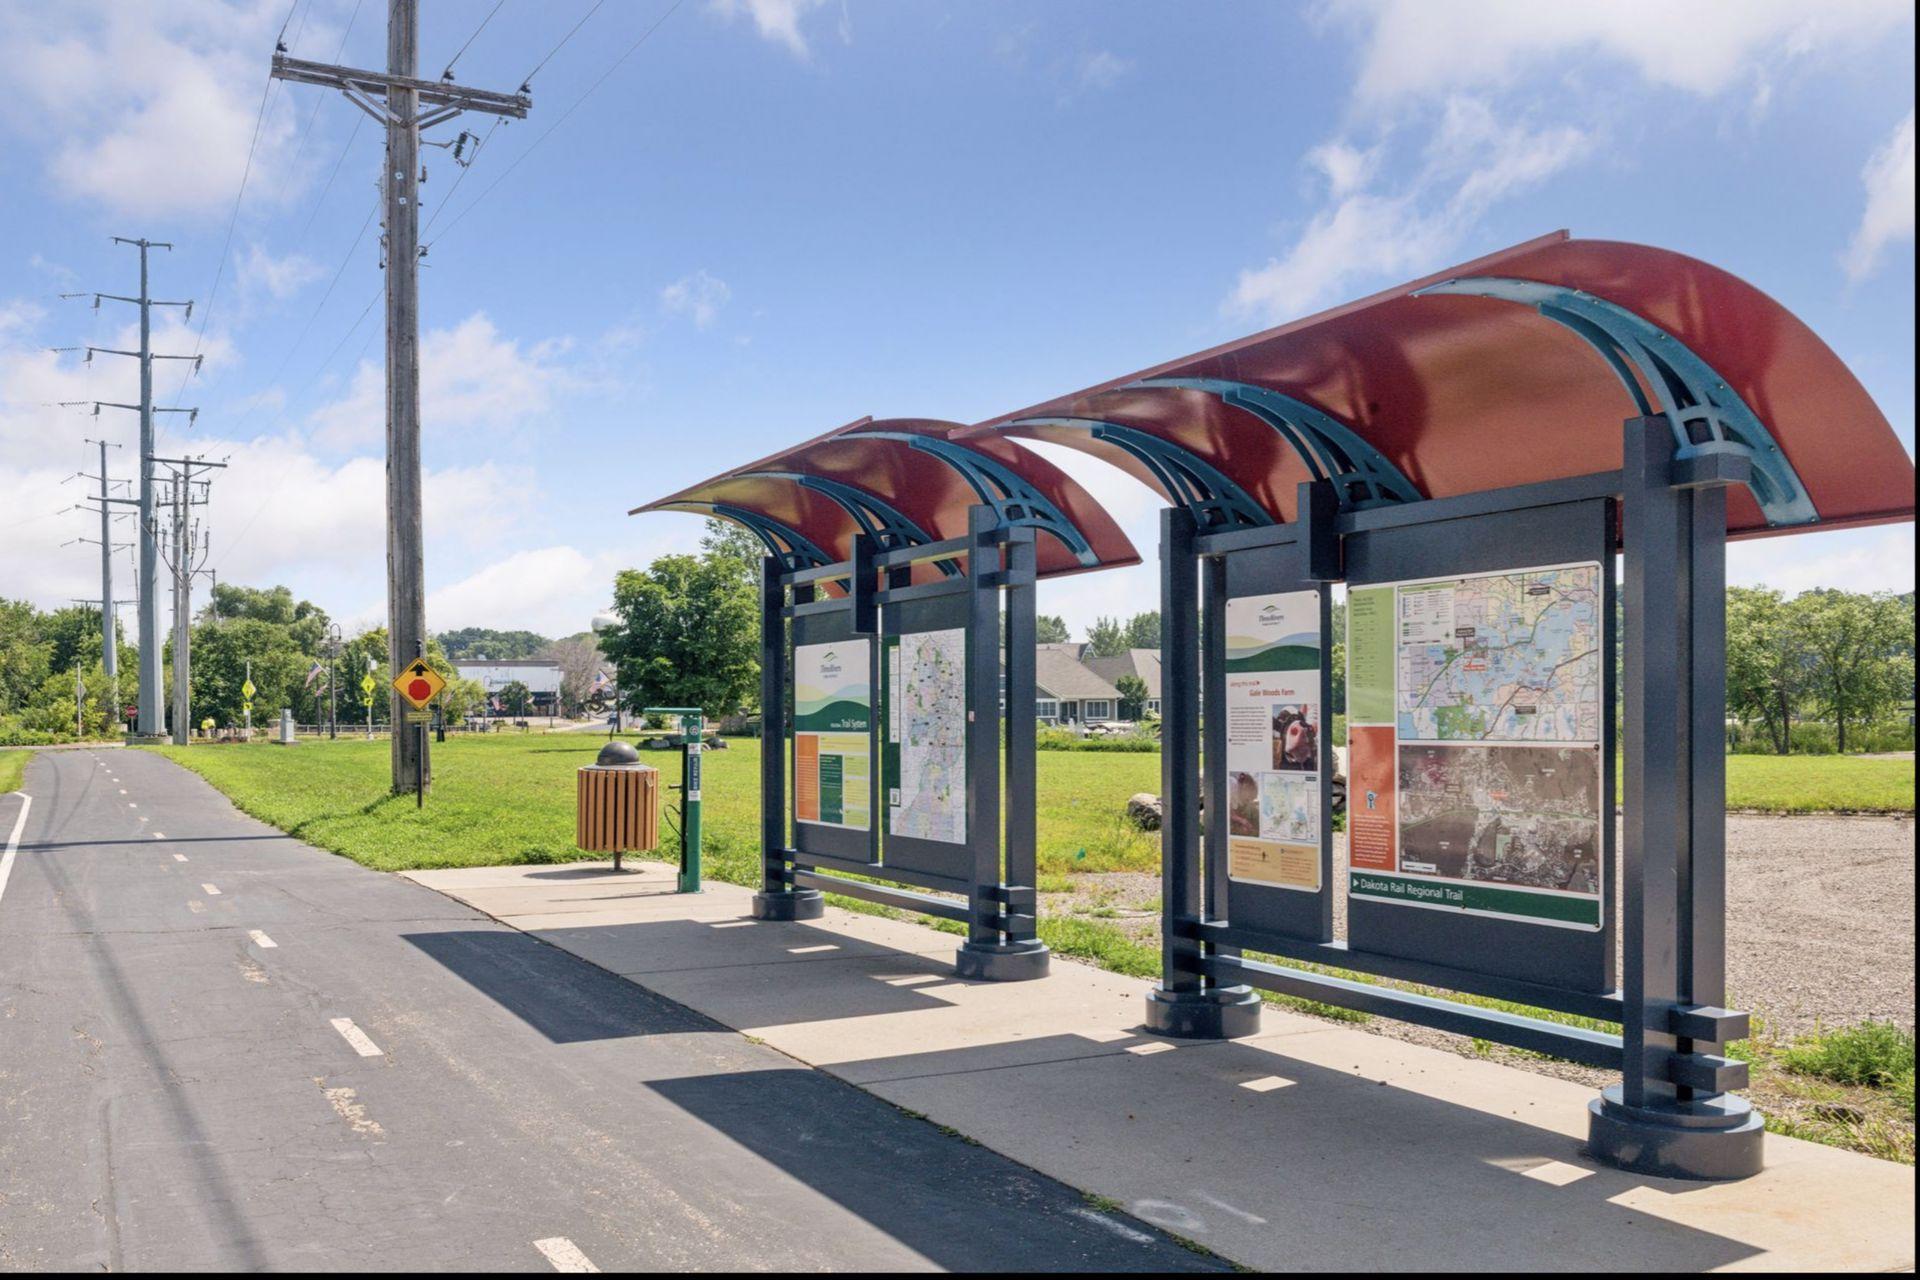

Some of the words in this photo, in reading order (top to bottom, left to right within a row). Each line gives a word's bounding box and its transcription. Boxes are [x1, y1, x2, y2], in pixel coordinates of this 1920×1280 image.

[1360, 879, 1388, 891] Dakota
[1390, 882, 1404, 893] Rail
[1407, 884, 1442, 898] Regional
[1445, 889, 1463, 900] Trail
